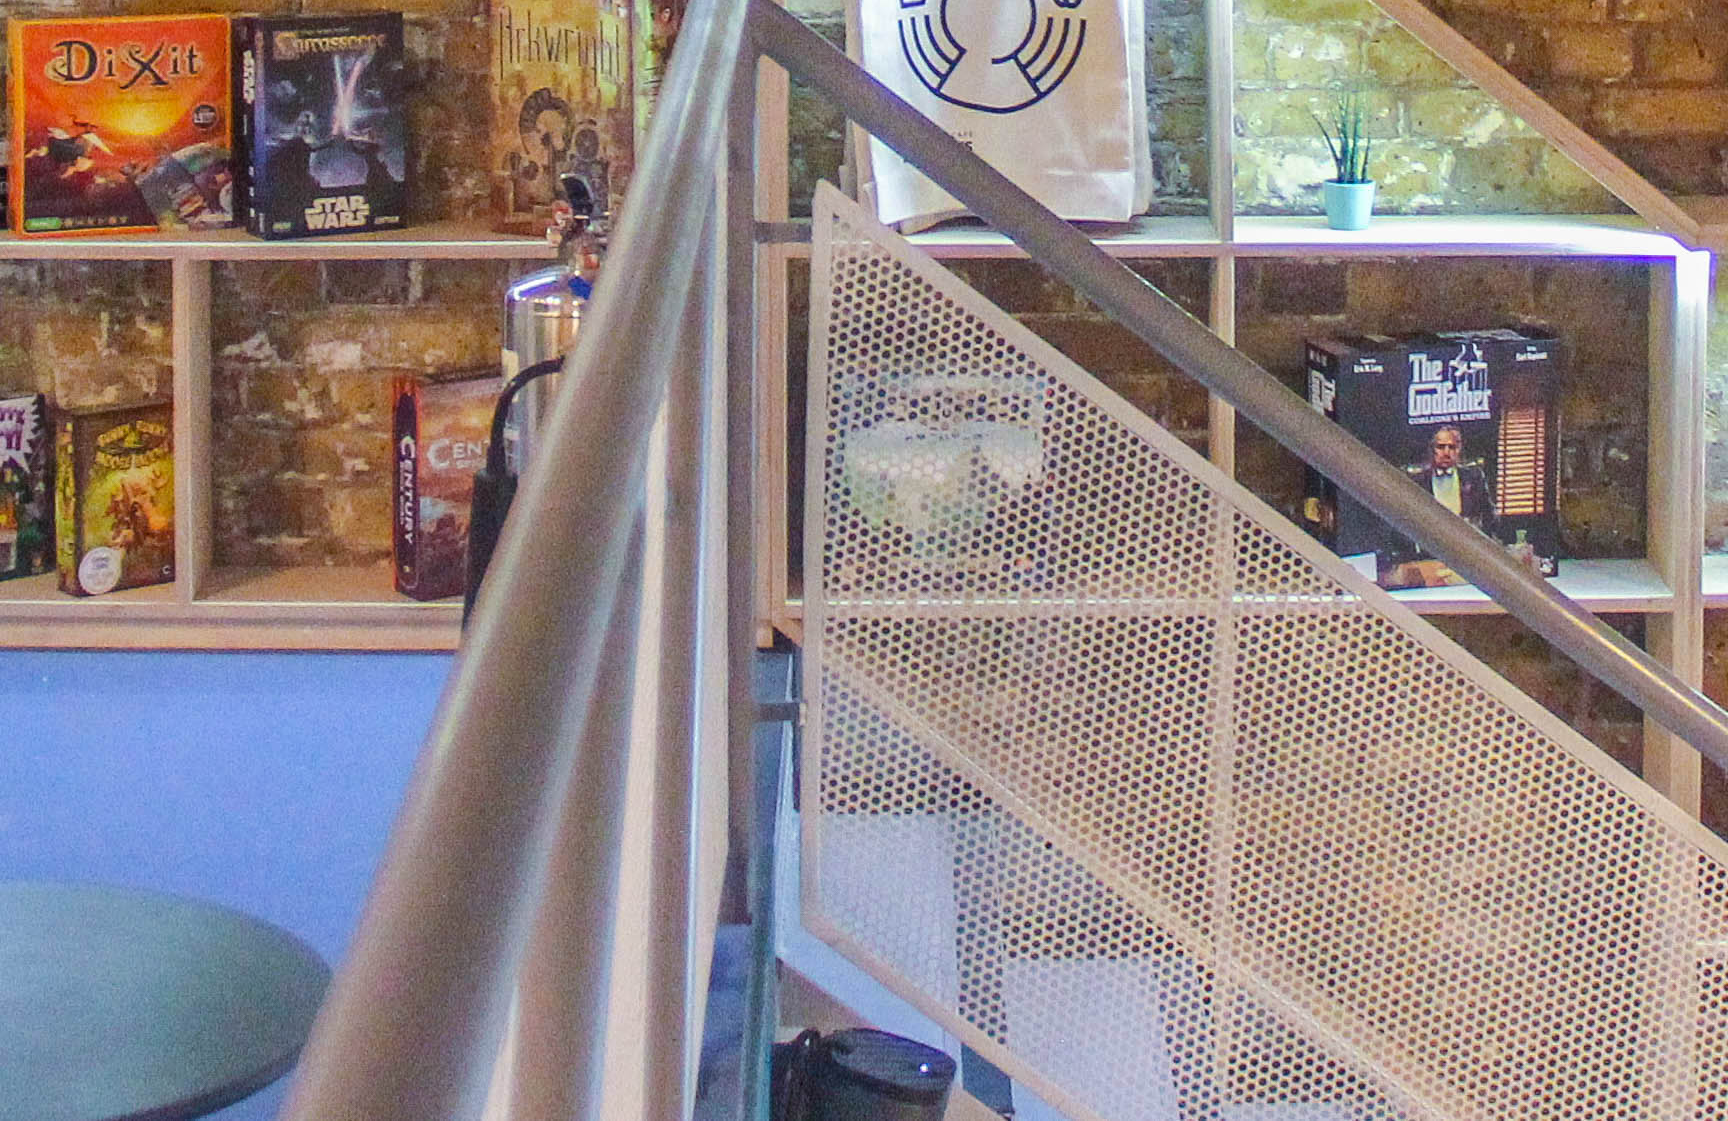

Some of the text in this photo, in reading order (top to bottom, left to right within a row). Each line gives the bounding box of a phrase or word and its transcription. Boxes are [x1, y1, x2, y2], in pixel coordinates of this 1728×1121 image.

[304, 209, 371, 231] WARS
[313, 195, 371, 214] STAR
[1408, 351, 1444, 383] The
[1408, 379, 1493, 417] Godfather
[401, 435, 416, 545] CENTURY
